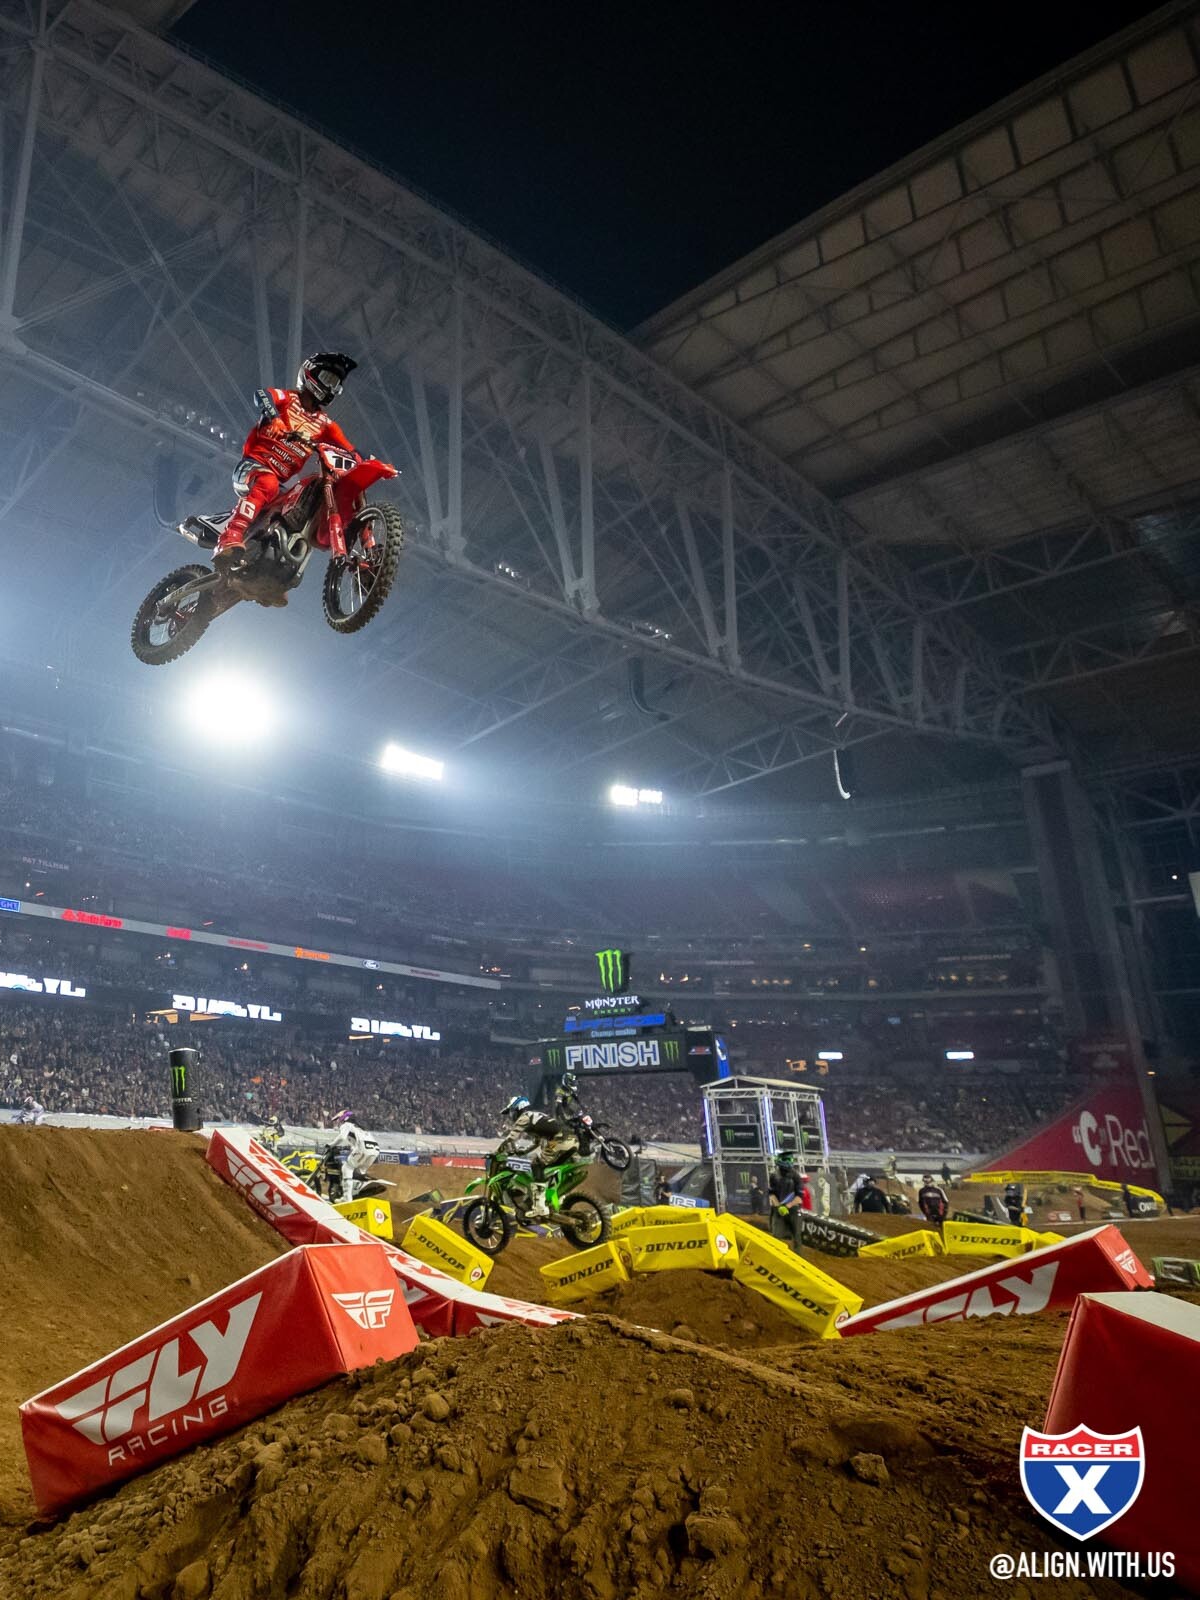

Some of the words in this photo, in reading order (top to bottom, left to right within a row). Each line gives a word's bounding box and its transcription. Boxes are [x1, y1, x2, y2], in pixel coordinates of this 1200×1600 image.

[585, 995, 640, 1009] MONSTER
[565, 1039, 660, 1071] FINISH
[1105, 1115, 1157, 1170] Red
[417, 1234, 466, 1273] DUNLOP
[645, 1238, 709, 1254] DUNLOP
[958, 1234, 1022, 1247] DUNLOP
[558, 1257, 614, 1288] DUNLOP
[754, 1264, 830, 1318] DUNLOP
[55, 1291, 264, 1446] FLY
[108, 1394, 229, 1467] RACING
